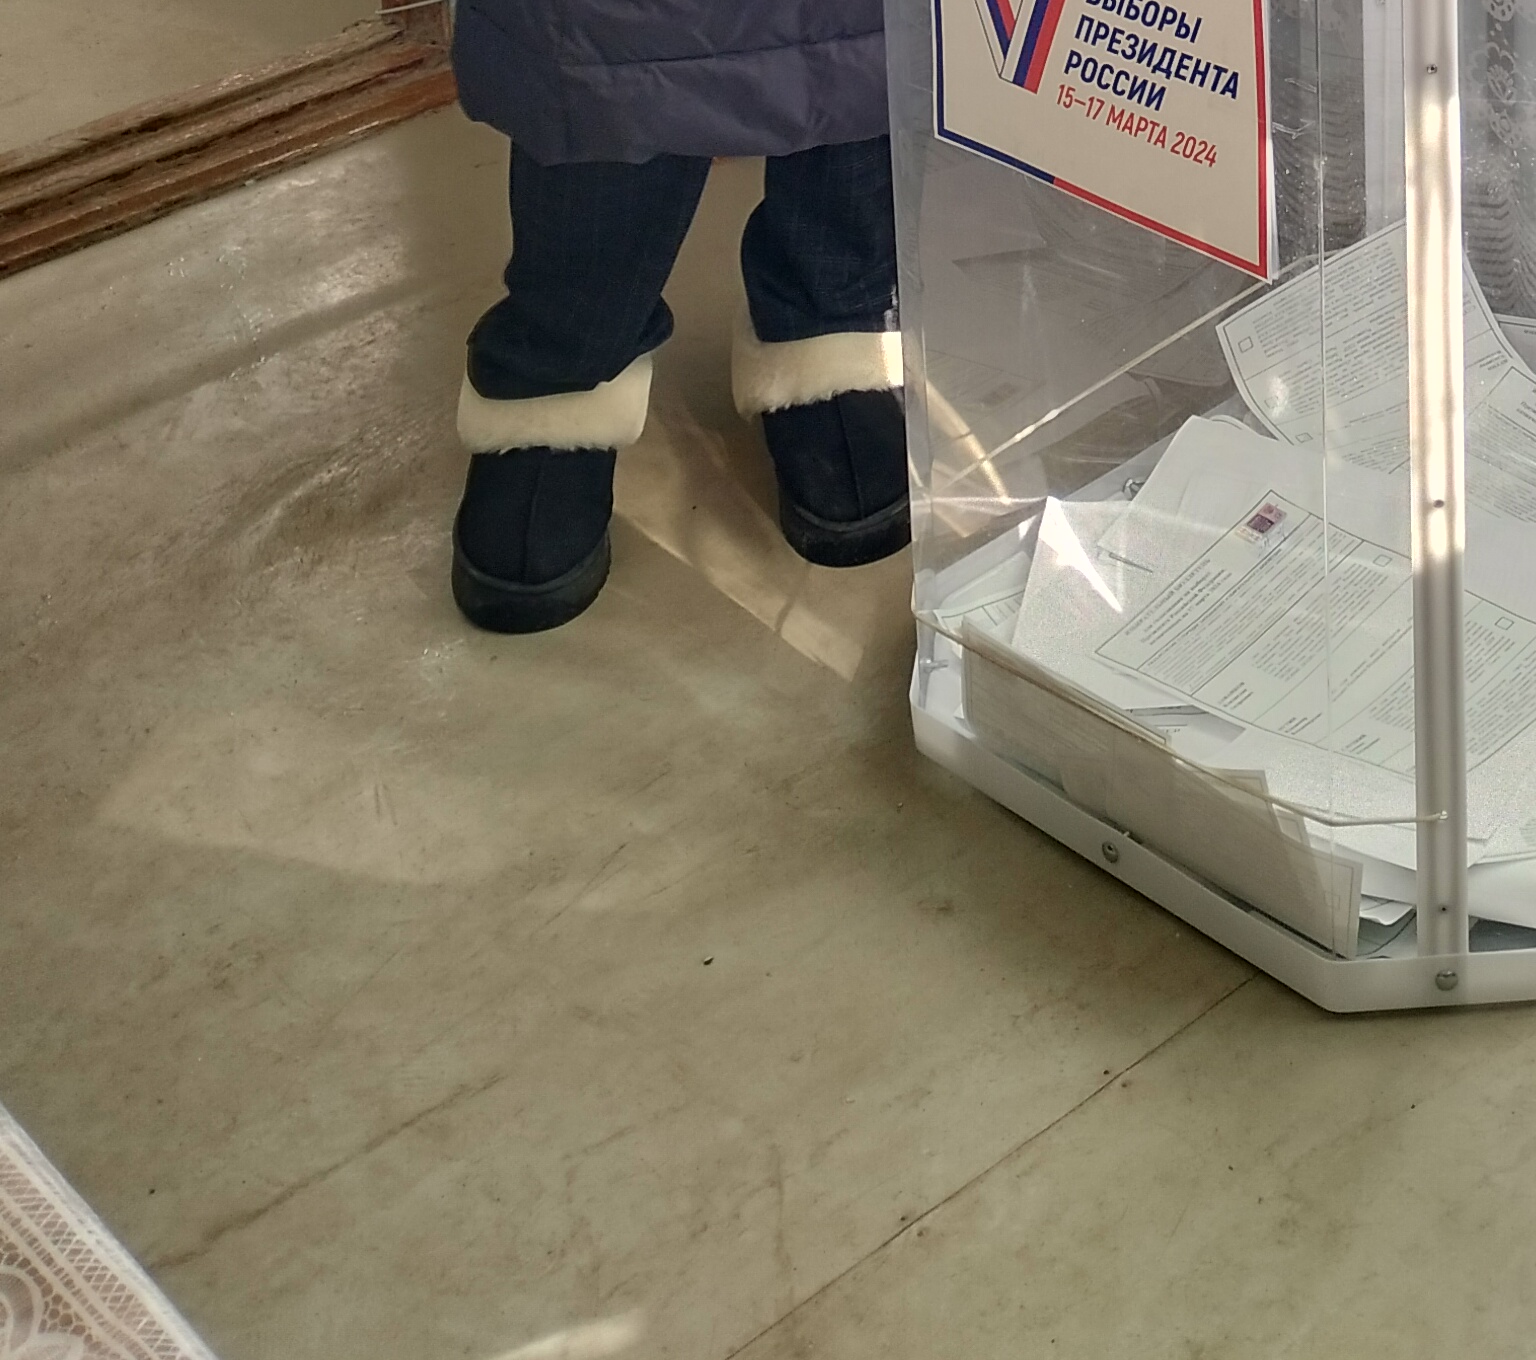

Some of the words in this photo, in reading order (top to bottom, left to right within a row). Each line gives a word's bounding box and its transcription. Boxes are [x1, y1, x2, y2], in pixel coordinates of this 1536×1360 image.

[1063, 49, 1167, 112] РОССИИ
[1074, 13, 1240, 100] ПРЕЗИДЕНТА
[1105, 103, 1168, 149] МАРТА
[1170, 131, 1218, 168] 2024
